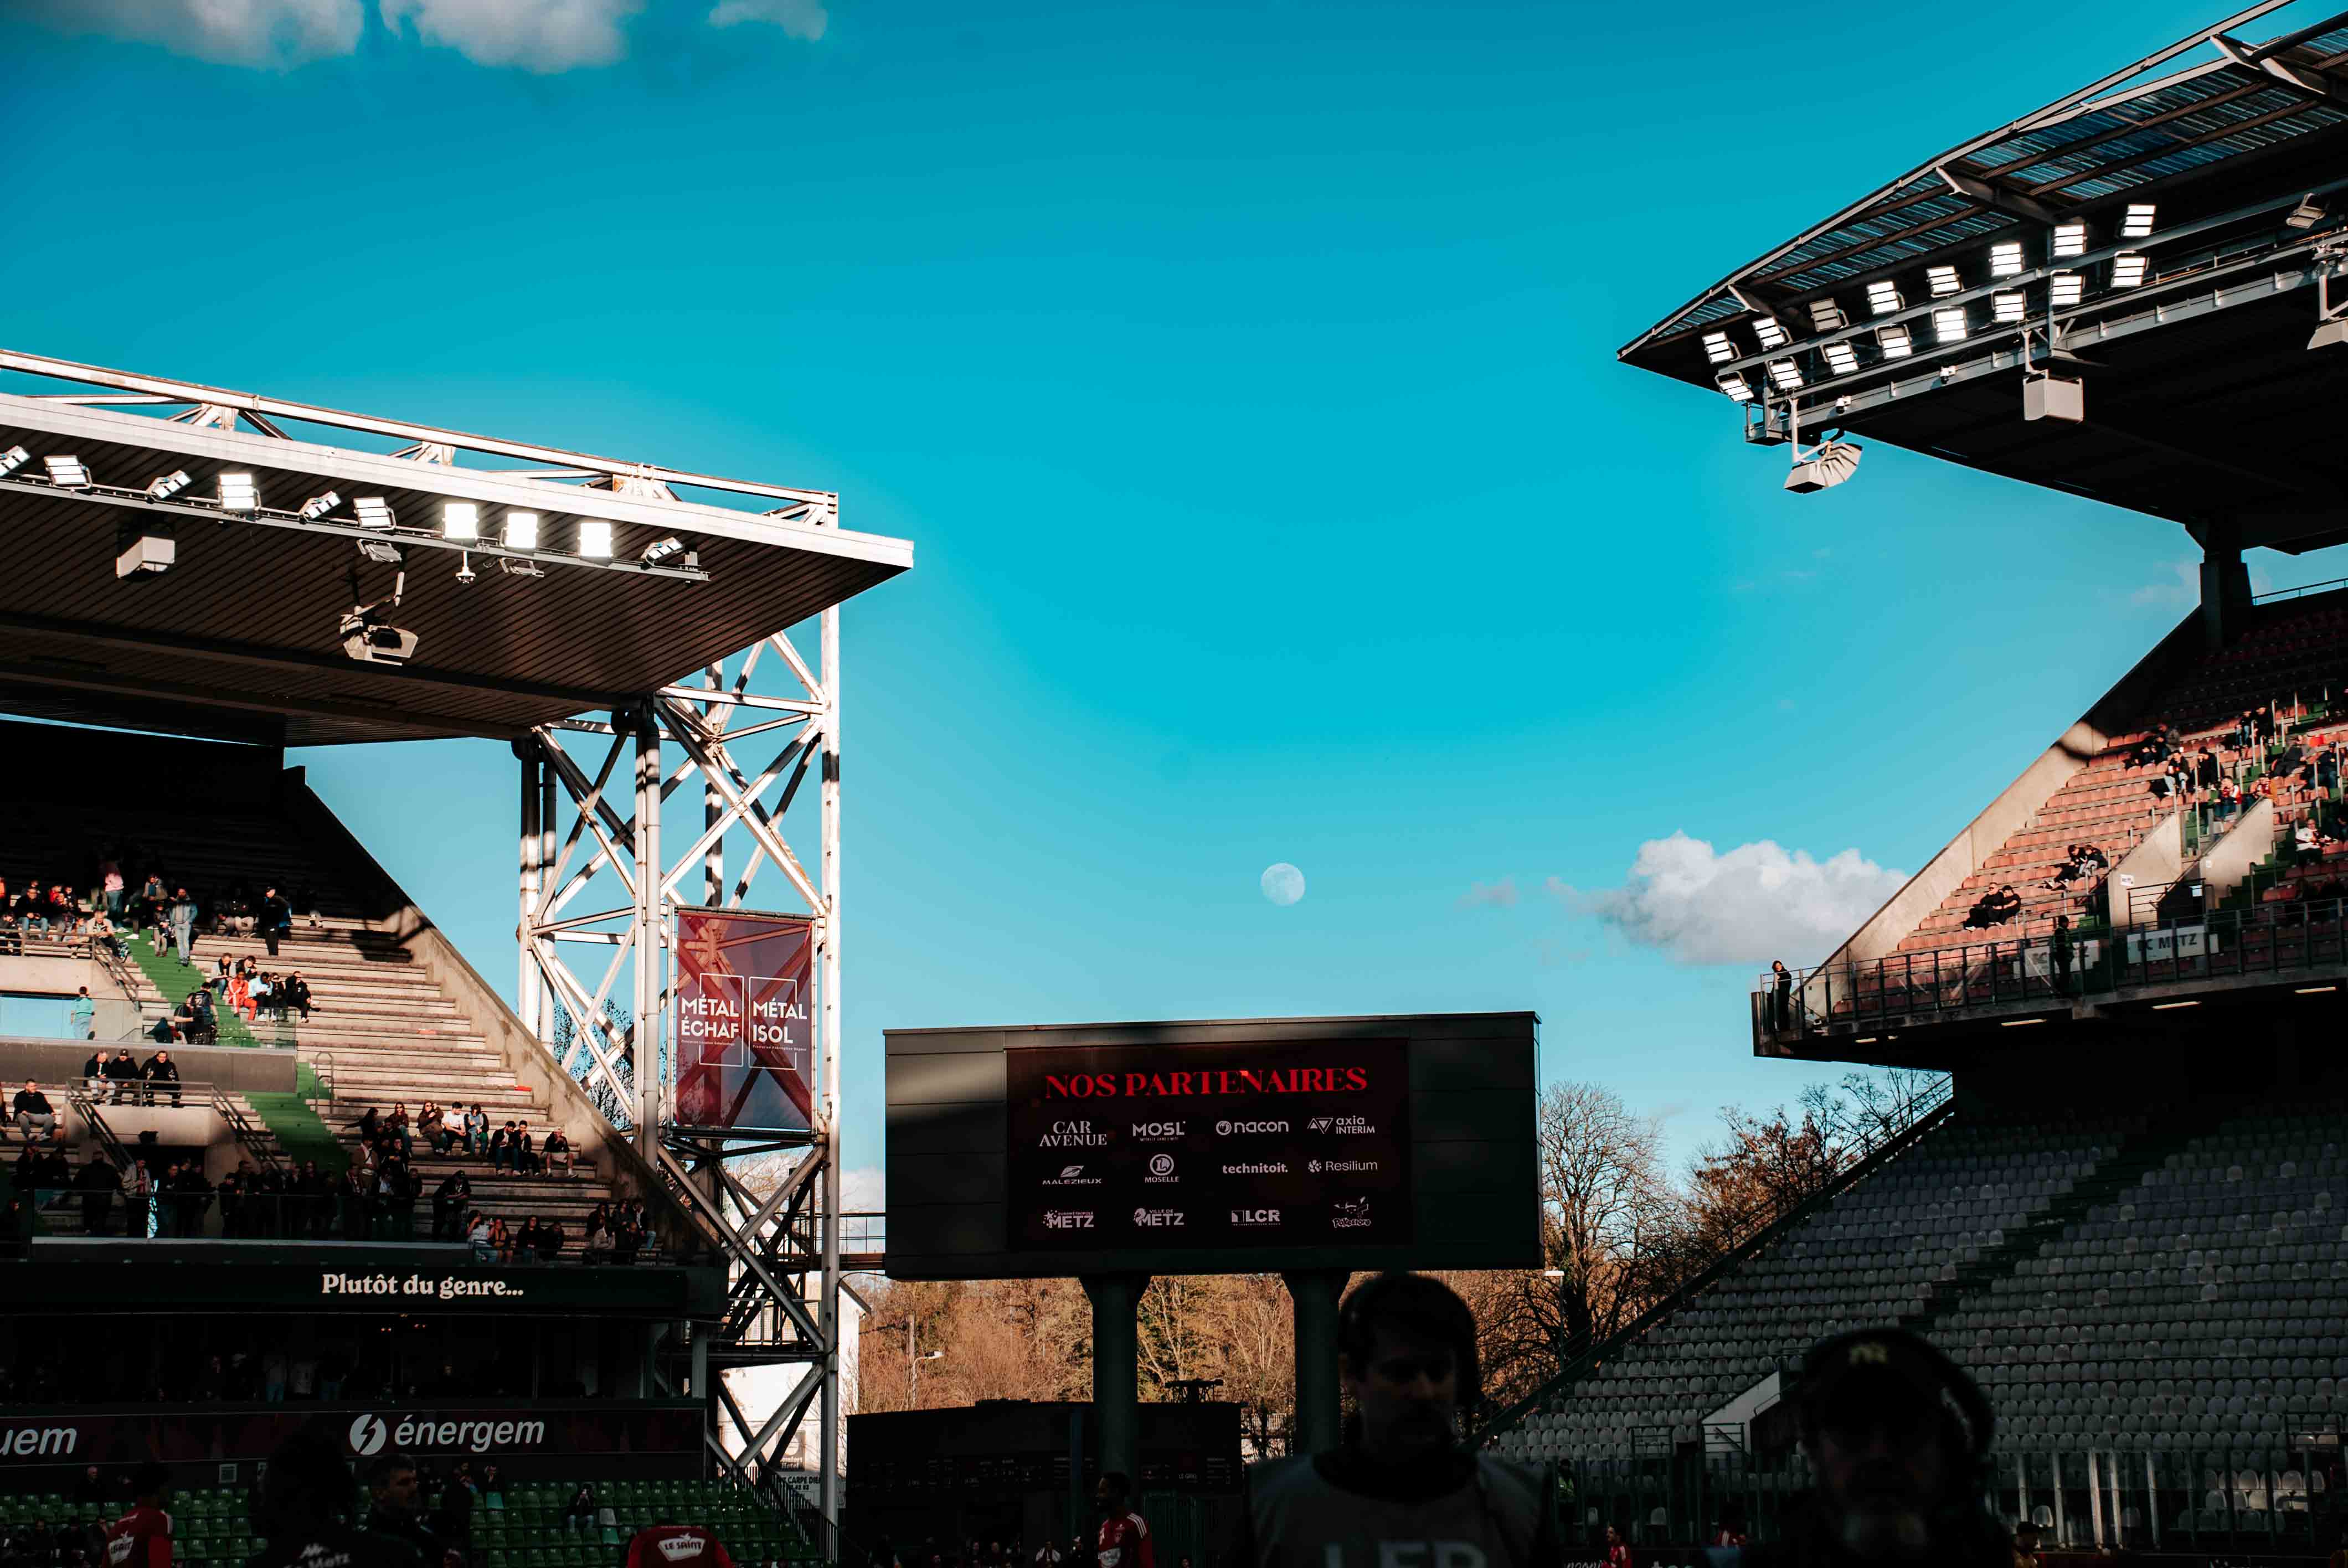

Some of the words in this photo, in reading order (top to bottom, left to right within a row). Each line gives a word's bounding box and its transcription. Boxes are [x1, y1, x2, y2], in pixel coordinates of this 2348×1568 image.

[682, 994, 739, 1017] MÉTAL
[753, 997, 807, 1019] MÉTAL
[681, 1015, 739, 1038] ÉCHAF
[753, 1024, 793, 1043] ISOL
[1046, 1073, 1117, 1099] NOS
[1125, 1067, 1368, 1097] PARTENAIRES
[1234, 1121, 1289, 1133] nacon
[1336, 1115, 1365, 1126] axia
[1053, 1121, 1091, 1134] CAR
[1336, 1126, 1376, 1134] INTERIM
[1039, 1134, 1108, 1147] AVENUE
[1326, 1160, 1378, 1171] Resilium
[1049, 1215, 1094, 1228] METZ
[1137, 1213, 1185, 1226] METZ
[1245, 1209, 1281, 1223] LCR
[322, 1273, 398, 1294] Plutôt
[403, 1274, 434, 1294] du
[439, 1276, 524, 1299] genre...
[394, 1414, 545, 1453] énergem
